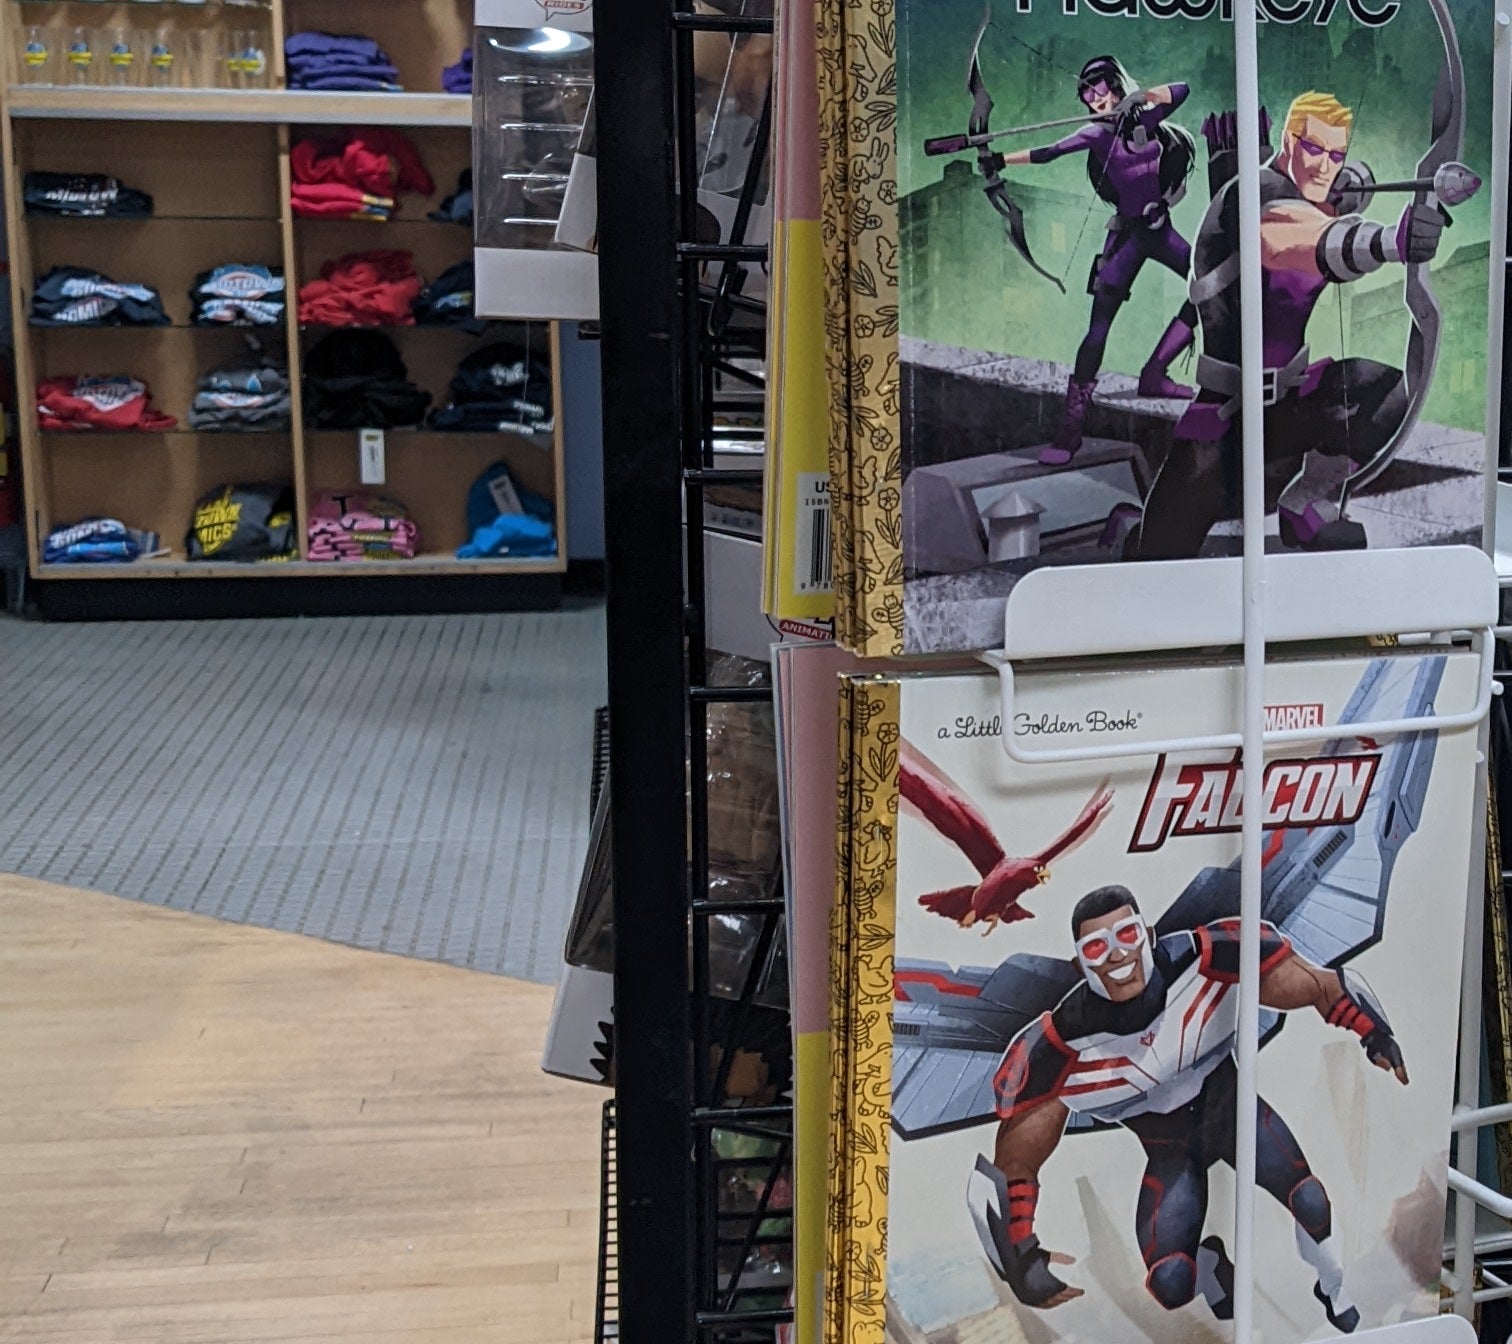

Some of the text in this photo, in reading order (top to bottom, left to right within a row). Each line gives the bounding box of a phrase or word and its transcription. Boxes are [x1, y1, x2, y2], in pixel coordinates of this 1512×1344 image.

[937, 725, 951, 740] a
[955, 715, 1003, 739] Littl
[1085, 709, 1139, 733] Book
